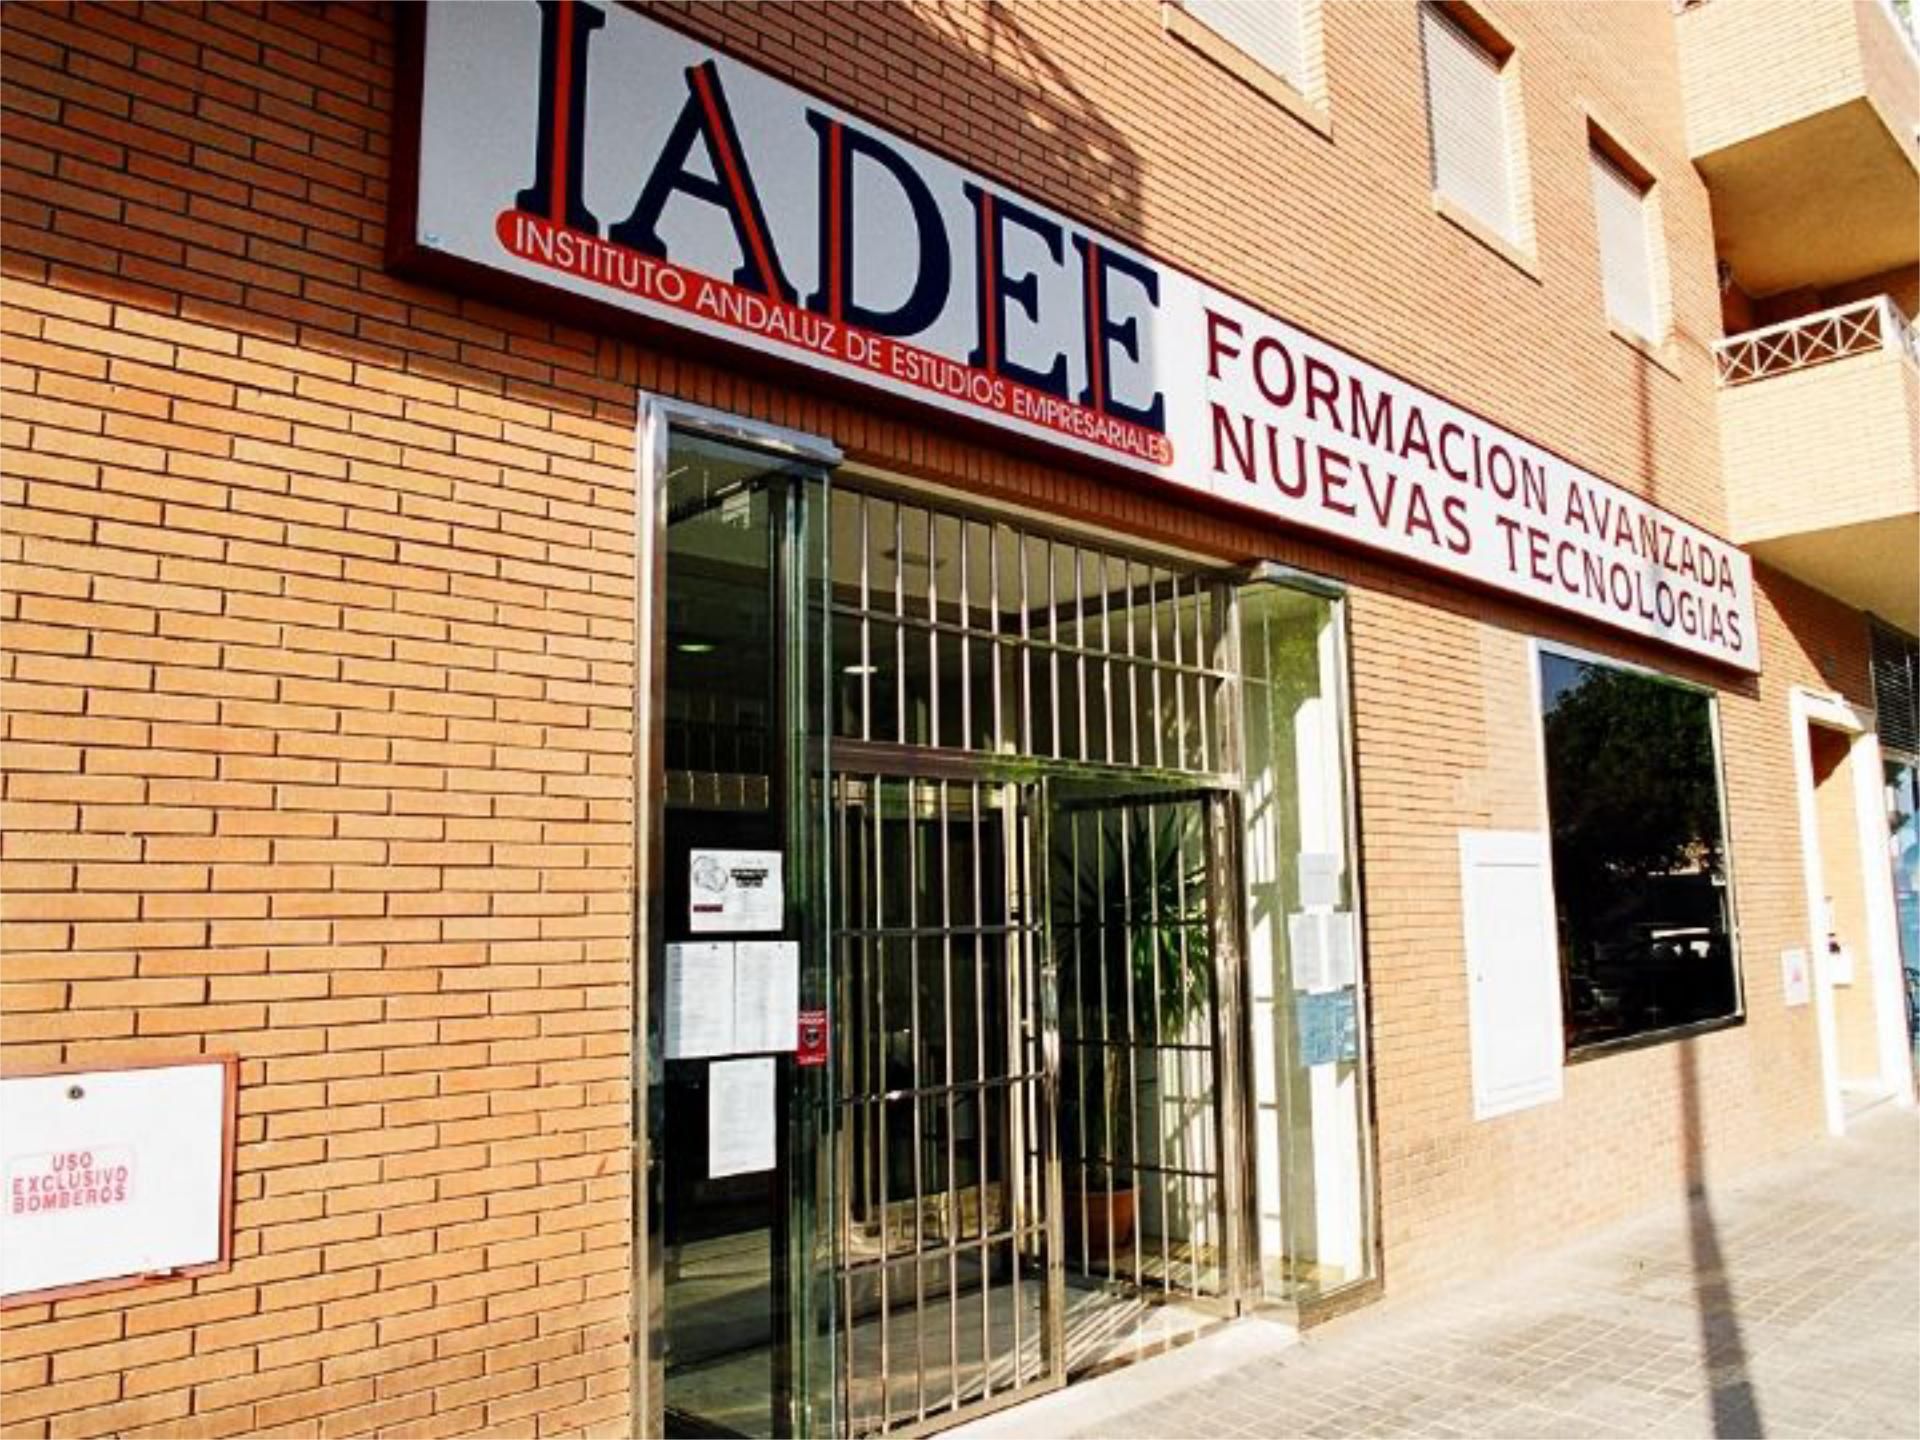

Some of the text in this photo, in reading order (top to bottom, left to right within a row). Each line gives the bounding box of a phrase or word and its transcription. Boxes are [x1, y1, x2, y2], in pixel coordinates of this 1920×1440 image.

[514, 216, 1170, 465] INSTITUTO ANDALUZ DE ESTUDIOS EMPRESARIALES
[516, 0, 1165, 432] IADEE
[1204, 308, 1737, 598] FORMACION AVANZADA
[1210, 402, 1744, 653] NUEVAS TECNOLOGIAS
[12, 1165, 129, 1195] EXCLUSIVO
[12, 1184, 126, 1214] BOMBEROS
[51, 1151, 93, 1172] USO
